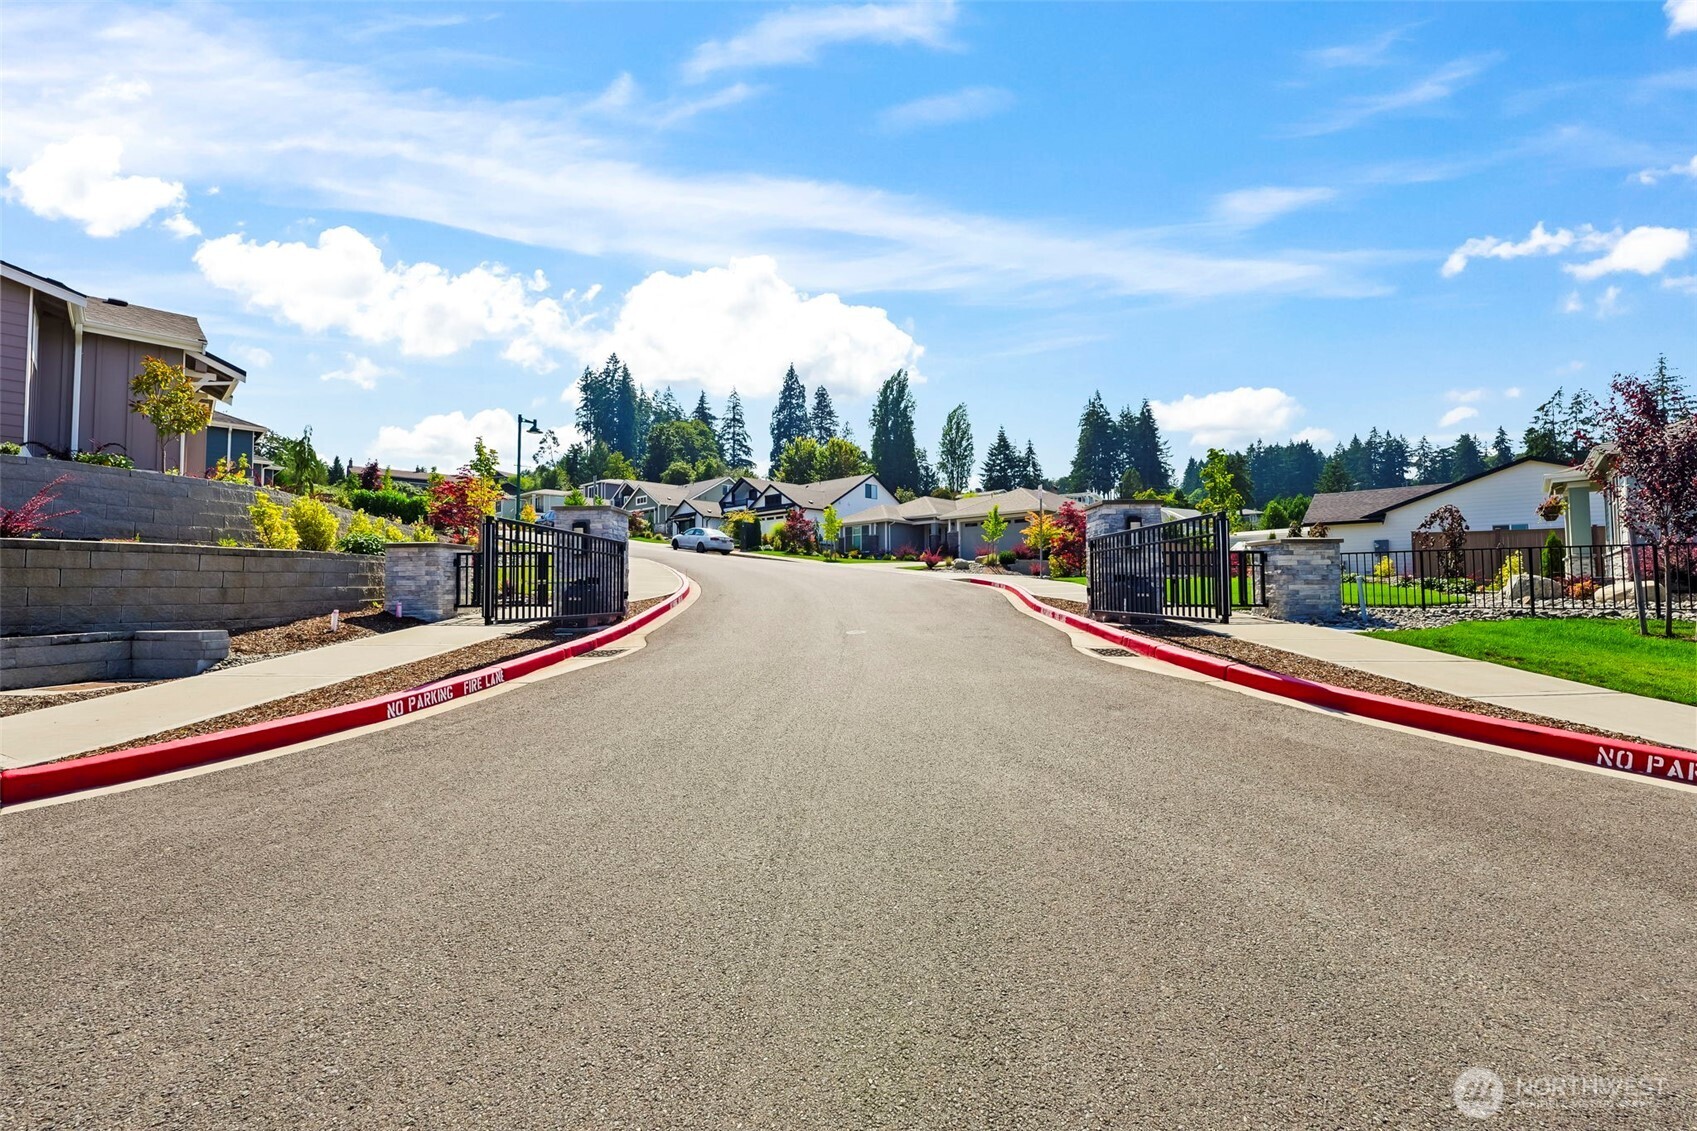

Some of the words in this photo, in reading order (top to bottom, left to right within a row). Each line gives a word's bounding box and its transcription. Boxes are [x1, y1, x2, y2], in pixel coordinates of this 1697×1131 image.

[386, 700, 404, 719] NO
[408, 685, 454, 712] PARKING
[463, 676, 482, 695] FIRE
[485, 670, 505, 687] LANE
[1596, 746, 1634, 770] NO
